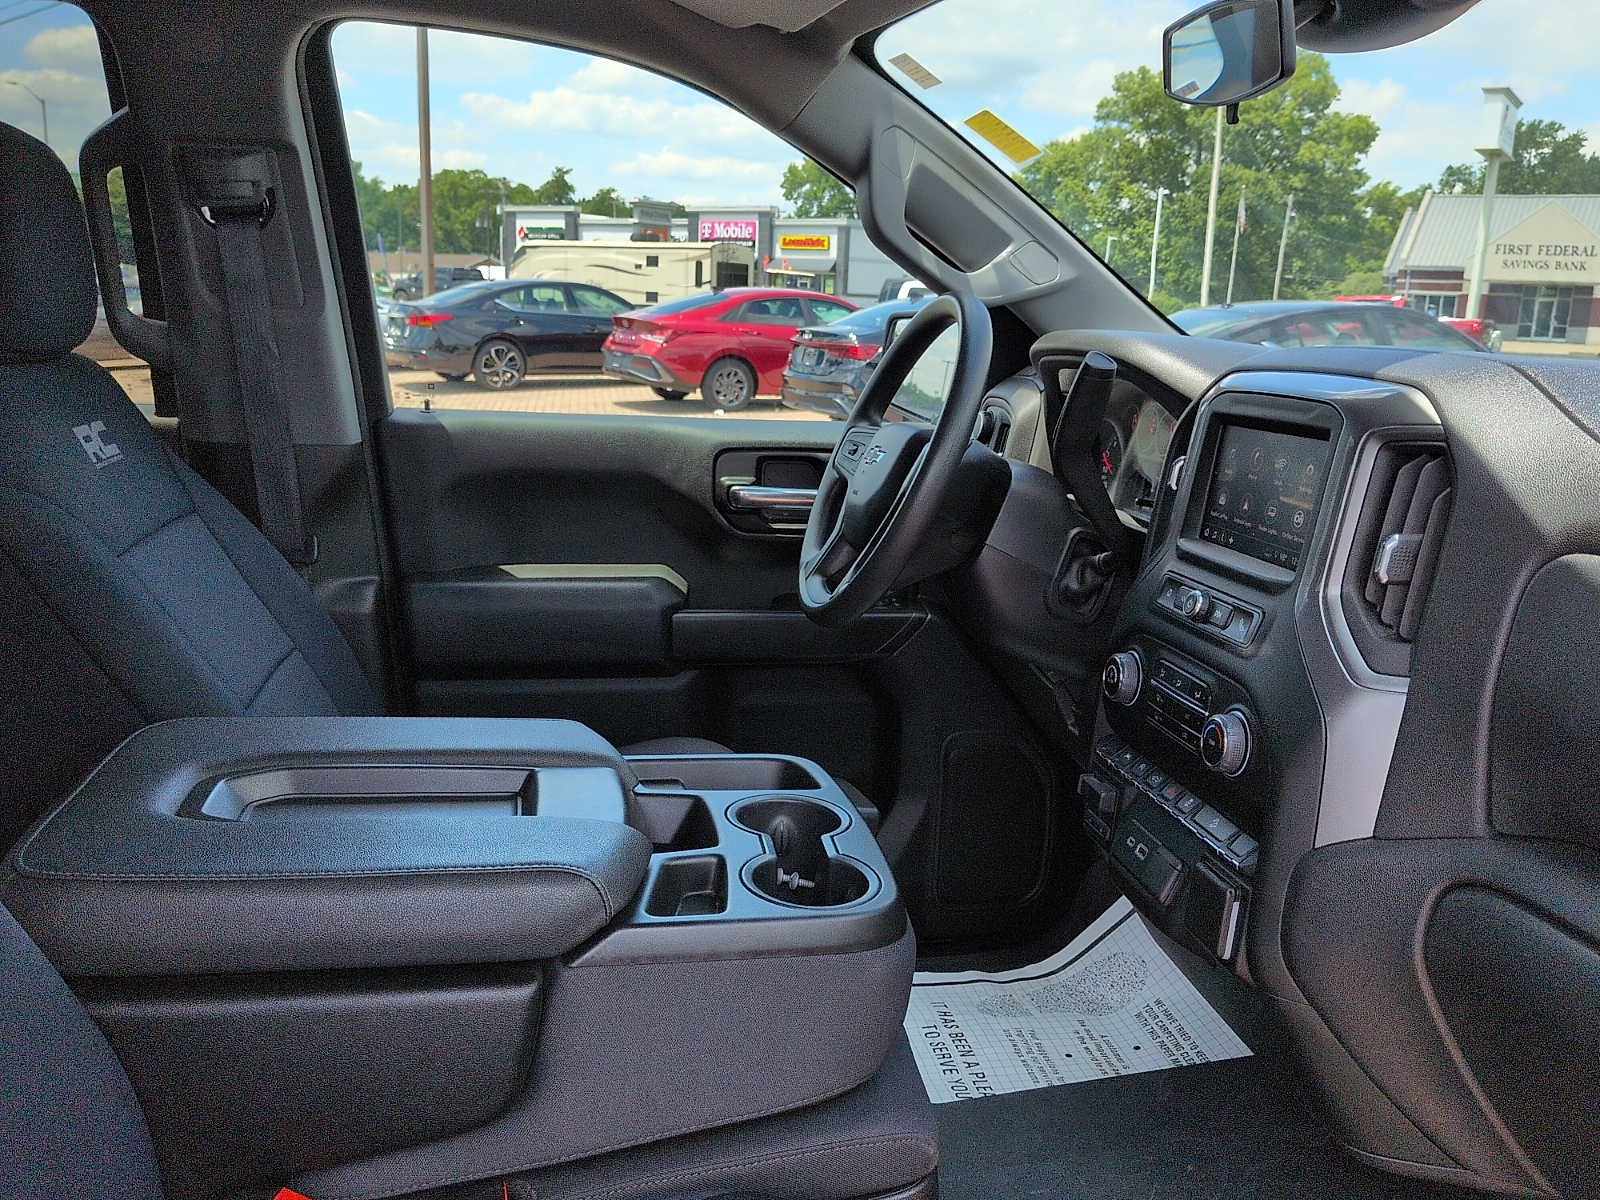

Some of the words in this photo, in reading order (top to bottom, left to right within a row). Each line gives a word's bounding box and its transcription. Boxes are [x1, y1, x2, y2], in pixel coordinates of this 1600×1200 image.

[714, 223, 753, 239] Mobile
[1495, 243, 1533, 255] FIRST
[1537, 244, 1598, 257] FEDERAL
[1502, 260, 1550, 270] SAVINGS
[1555, 261, 1588, 271] BANK
[929, 1001, 949, 1009] IT
[936, 1010, 960, 1030] HAS
[1143, 1003, 1160, 1021] YOUR
[1155, 1020, 1185, 1052] CARPETING
[1154, 996, 1166, 1010] WE
[1161, 1008, 1178, 1025] HAVE
[1187, 1040, 1199, 1051] TO
[921, 1024, 941, 1039] TO
[1134, 1011, 1151, 1029] WITH
[1145, 1026, 1161, 1041] THIS
[1155, 1040, 1176, 1058] PAPER
[948, 1032, 976, 1058] BEEN
[929, 1041, 960, 1076] SERVE
[962, 1061, 980, 1069] A
